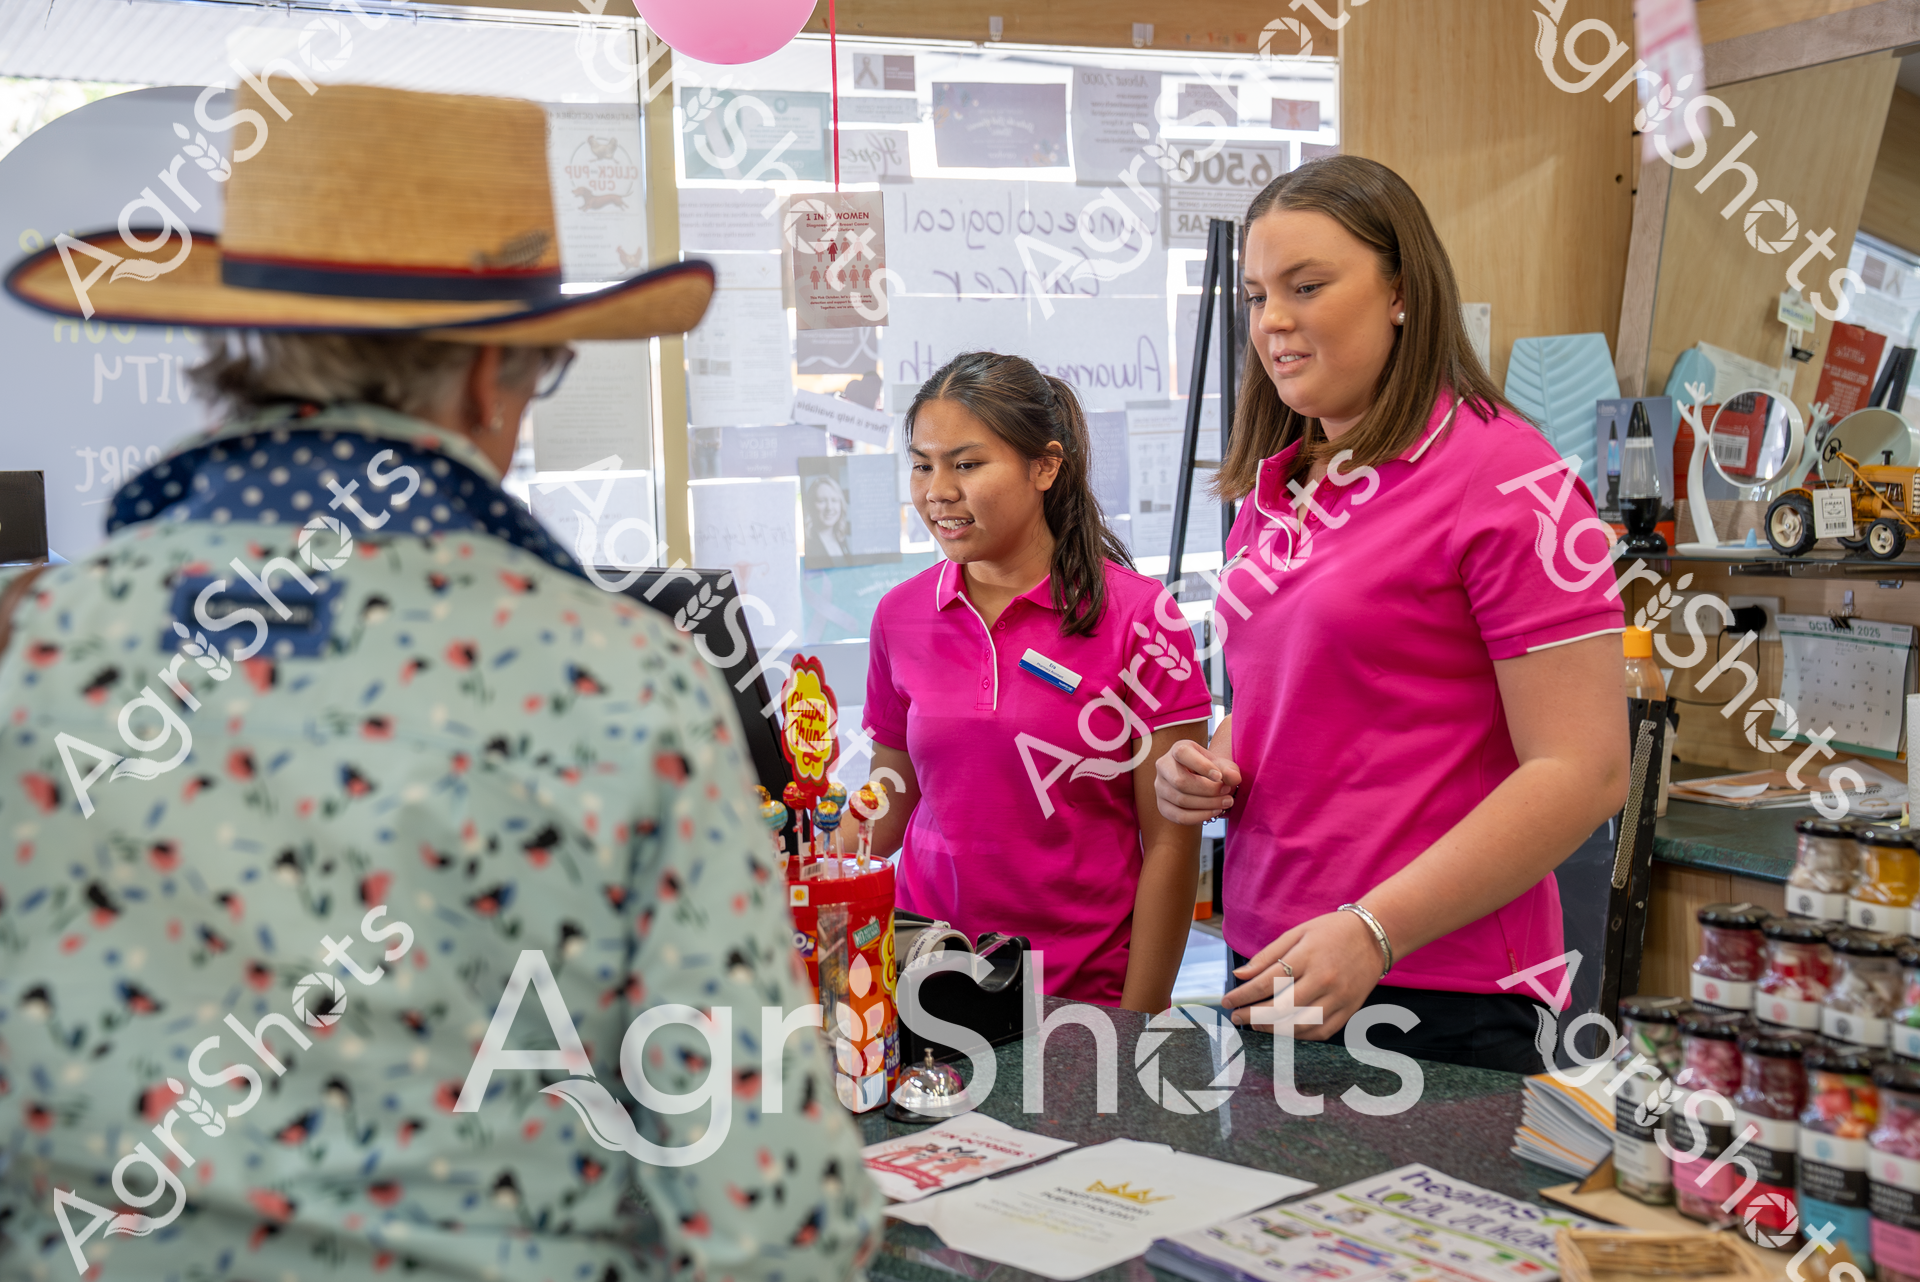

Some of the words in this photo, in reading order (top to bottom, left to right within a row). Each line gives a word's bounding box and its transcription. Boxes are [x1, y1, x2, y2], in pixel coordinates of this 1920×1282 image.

[813, 213, 824, 221] IN
[834, 212, 870, 221] WOMEN
[1857, 625, 1881, 639] 2025
[790, 691, 827, 728] Chupa
[790, 719, 826, 753] Chups
